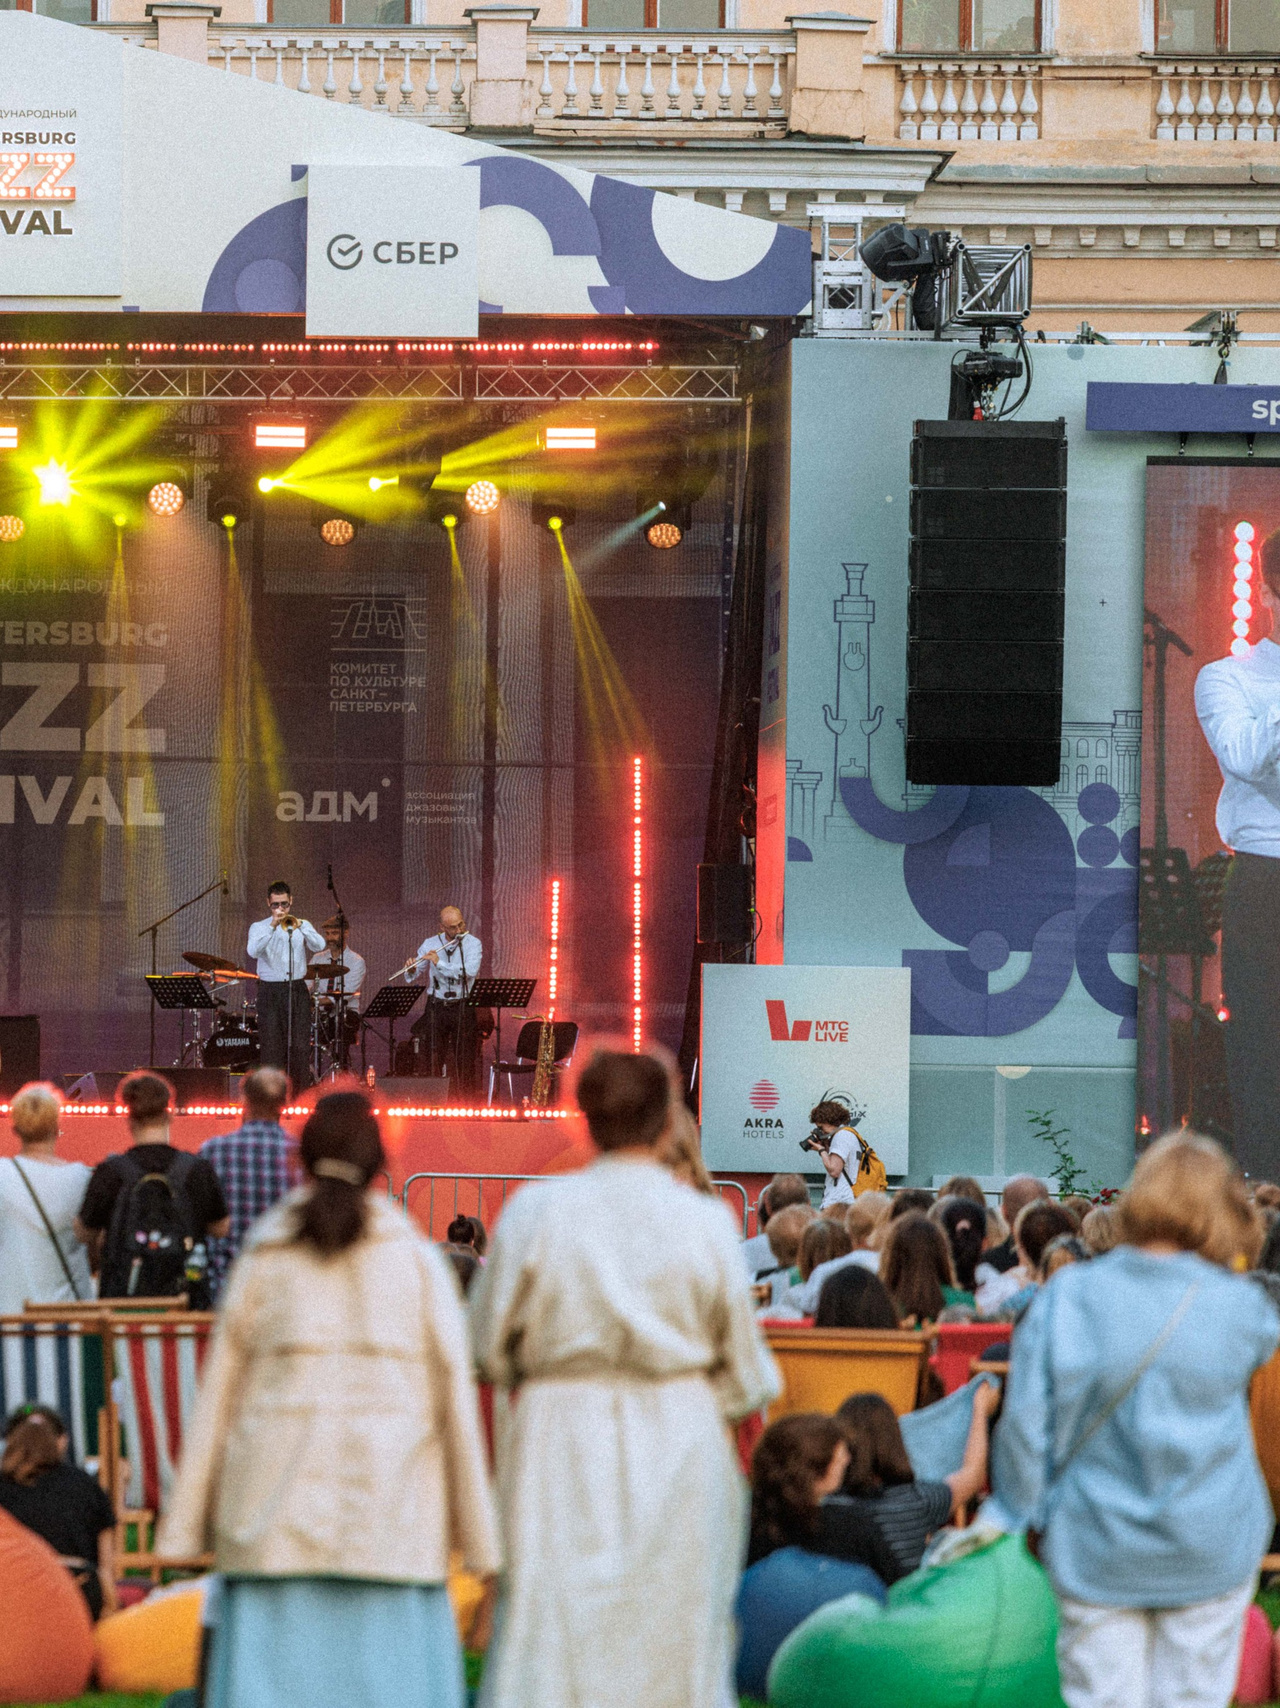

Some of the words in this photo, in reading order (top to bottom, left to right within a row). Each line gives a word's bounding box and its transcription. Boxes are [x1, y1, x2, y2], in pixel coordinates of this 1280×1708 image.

[373, 241, 459, 265] СБЕР
[330, 663, 397, 674] КОМИТЕТ
[330, 676, 351, 687] ПО
[355, 676, 427, 687] КУЛЬТУРЕ
[329, 701, 418, 713] ПЕТЕРБУРГА
[815, 1032, 849, 1042] LIVE
[744, 1118, 784, 1129] AKRA
[742, 1130, 785, 1139] HOTELS
